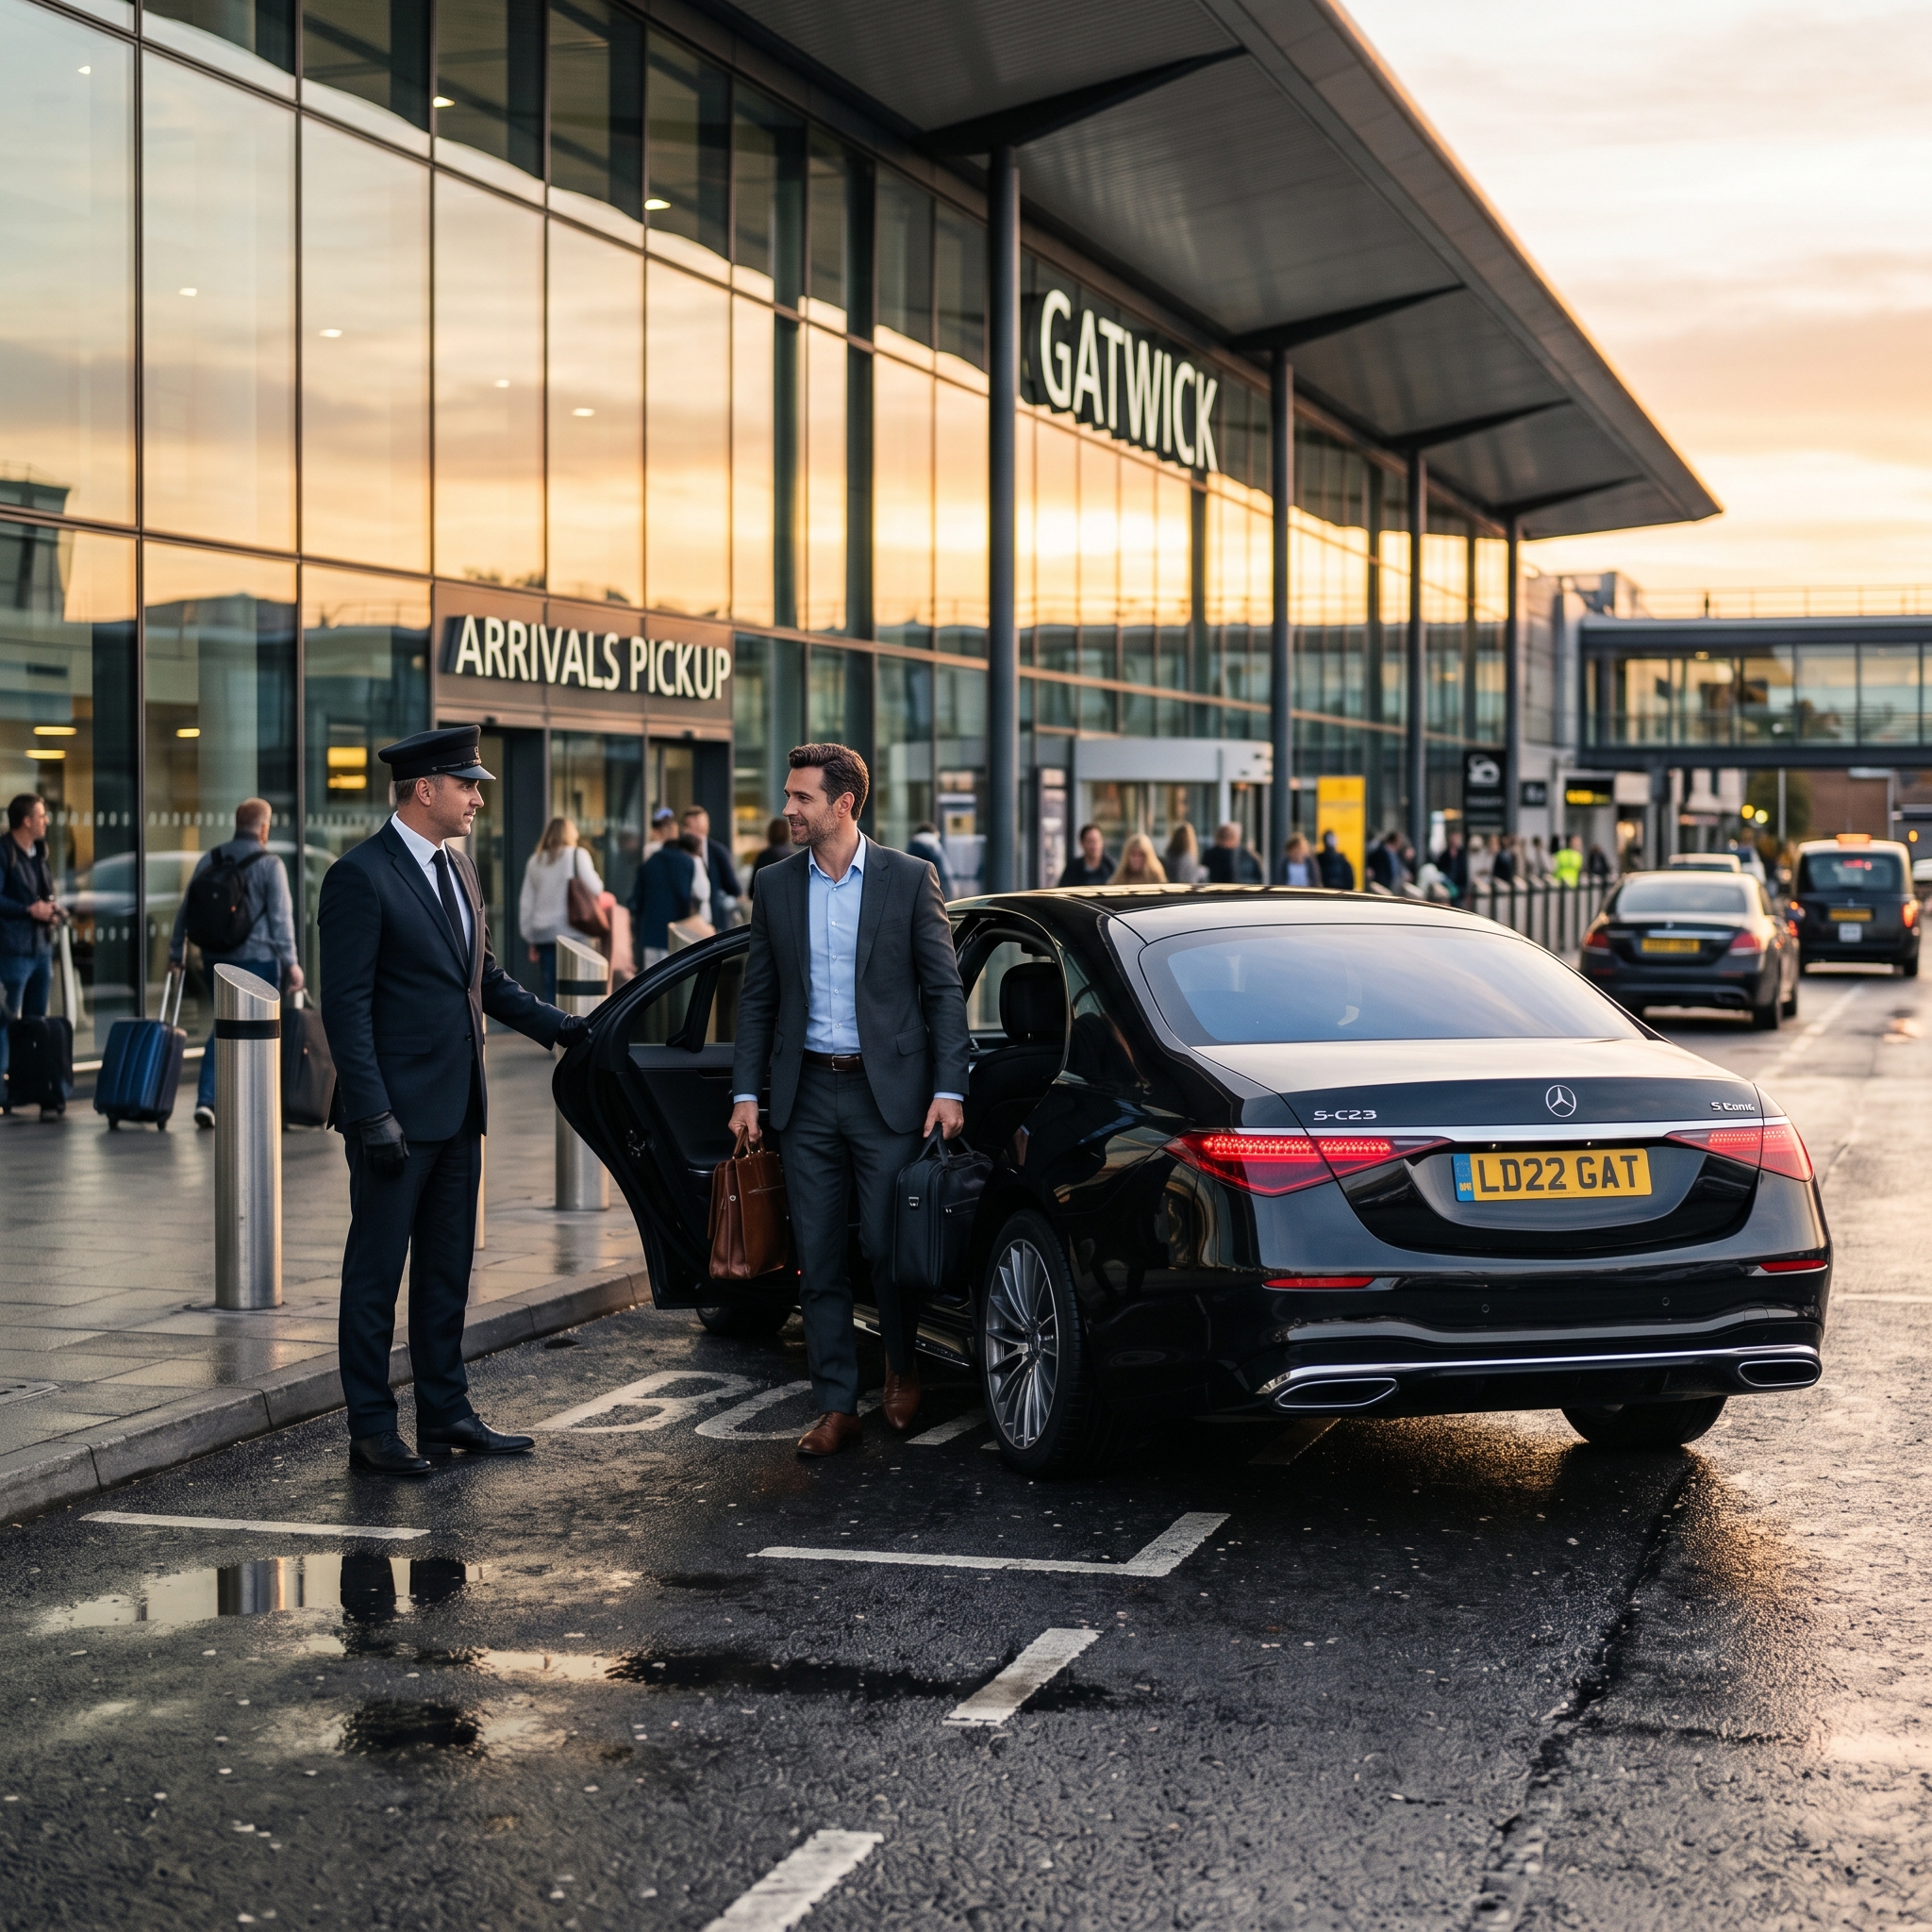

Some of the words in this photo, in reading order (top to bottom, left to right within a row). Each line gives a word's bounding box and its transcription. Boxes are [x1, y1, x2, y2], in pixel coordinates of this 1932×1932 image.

[1040, 289, 1219, 473] GATWICK
[455, 614, 621, 691] ARRIVALS
[629, 635, 732, 700] PICKUP
[1313, 1109, 1377, 1121] S-C23
[1709, 1101, 1722, 1111] S
[1477, 1157, 1568, 1193] LD22
[1575, 1155, 1639, 1190] GAT
